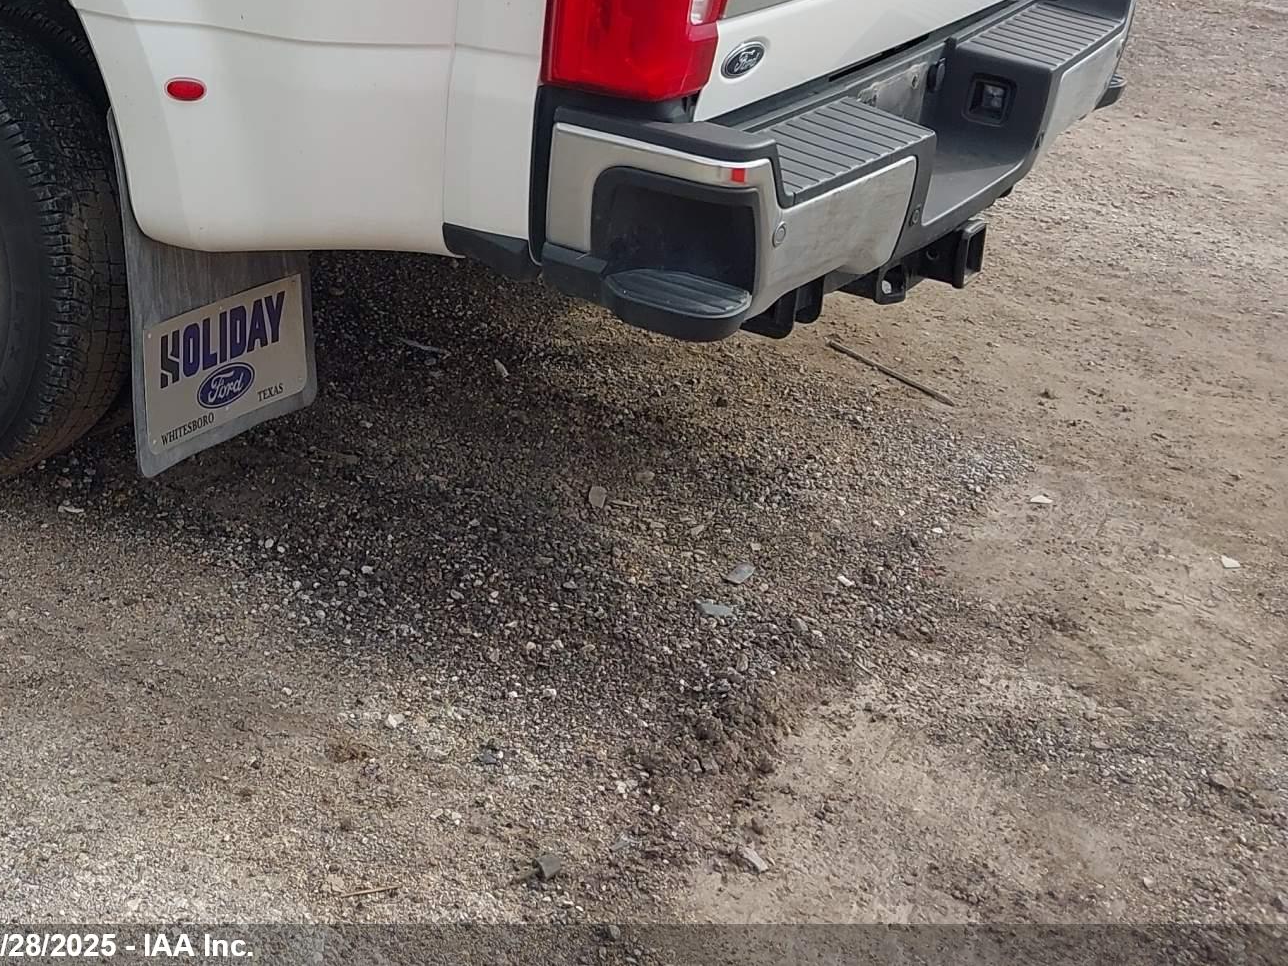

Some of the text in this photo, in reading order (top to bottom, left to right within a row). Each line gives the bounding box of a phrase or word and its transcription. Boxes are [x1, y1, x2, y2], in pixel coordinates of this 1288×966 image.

[733, 49, 760, 73] Ford
[160, 290, 286, 389] HOLIDAY
[207, 370, 245, 403] Ford
[160, 382, 284, 446] WHITESBORO TEXAS
